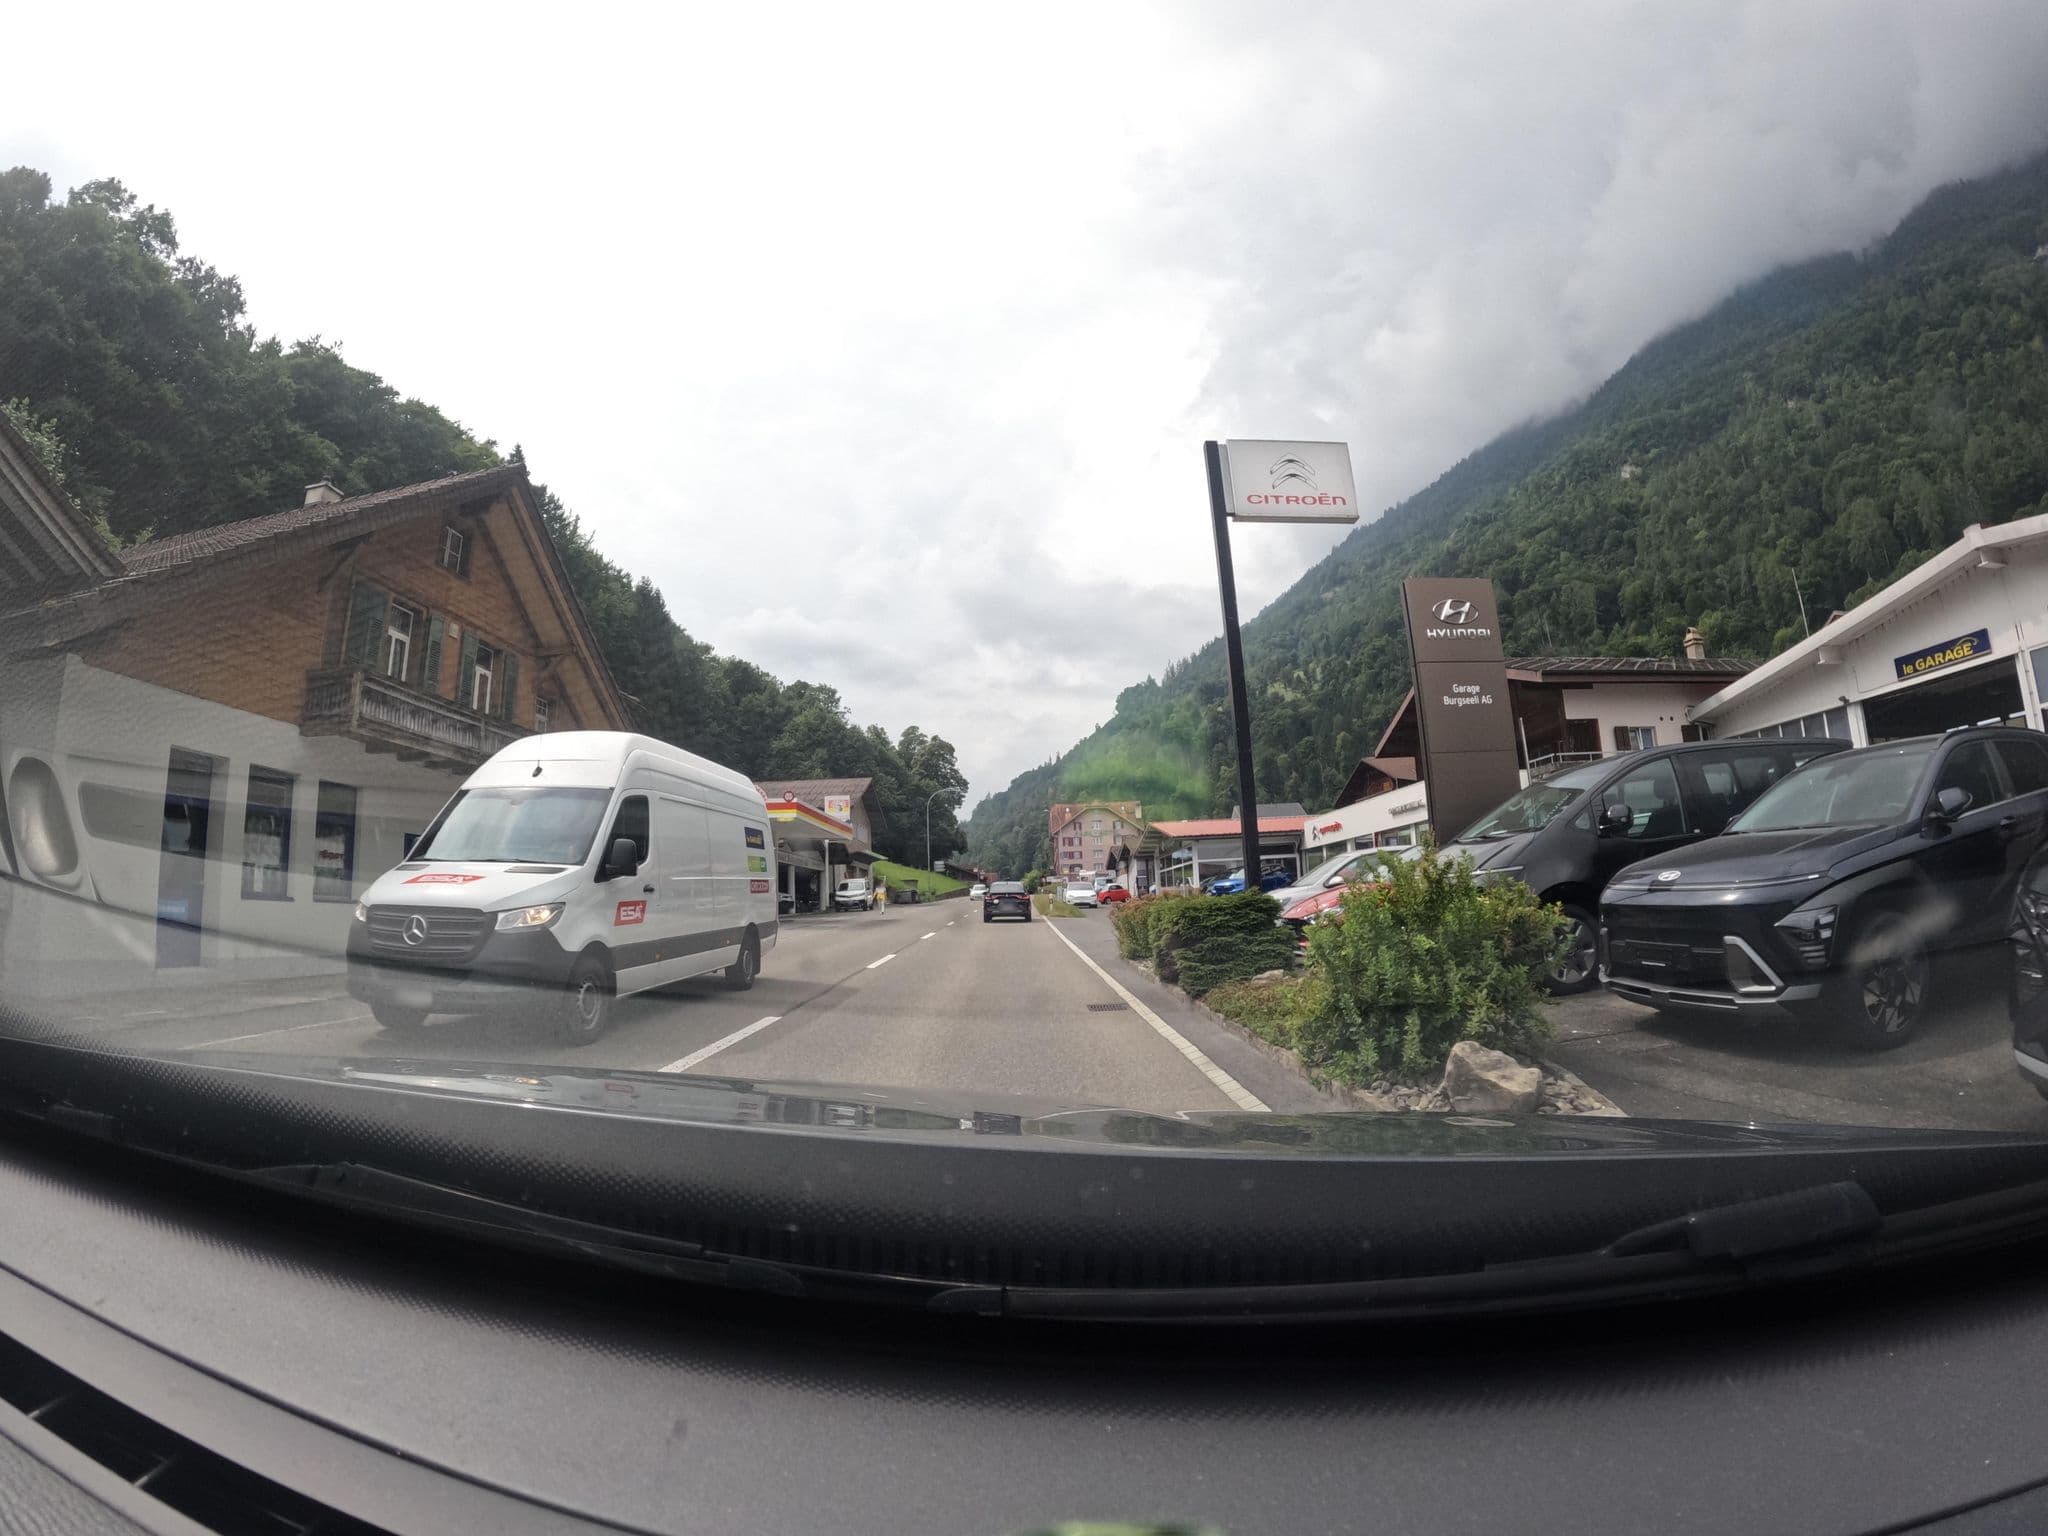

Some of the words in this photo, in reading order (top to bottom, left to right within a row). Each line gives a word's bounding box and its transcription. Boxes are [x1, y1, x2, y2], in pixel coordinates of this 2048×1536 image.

[1247, 493, 1347, 506] CITROËN
[1427, 628, 1491, 638] HYUNDAI
[1902, 663, 1914, 676] le
[1915, 642, 1974, 671] GARAGE
[1452, 684, 1481, 695] Garage
[1481, 694, 1493, 704] AG
[620, 906, 643, 921] ESA
